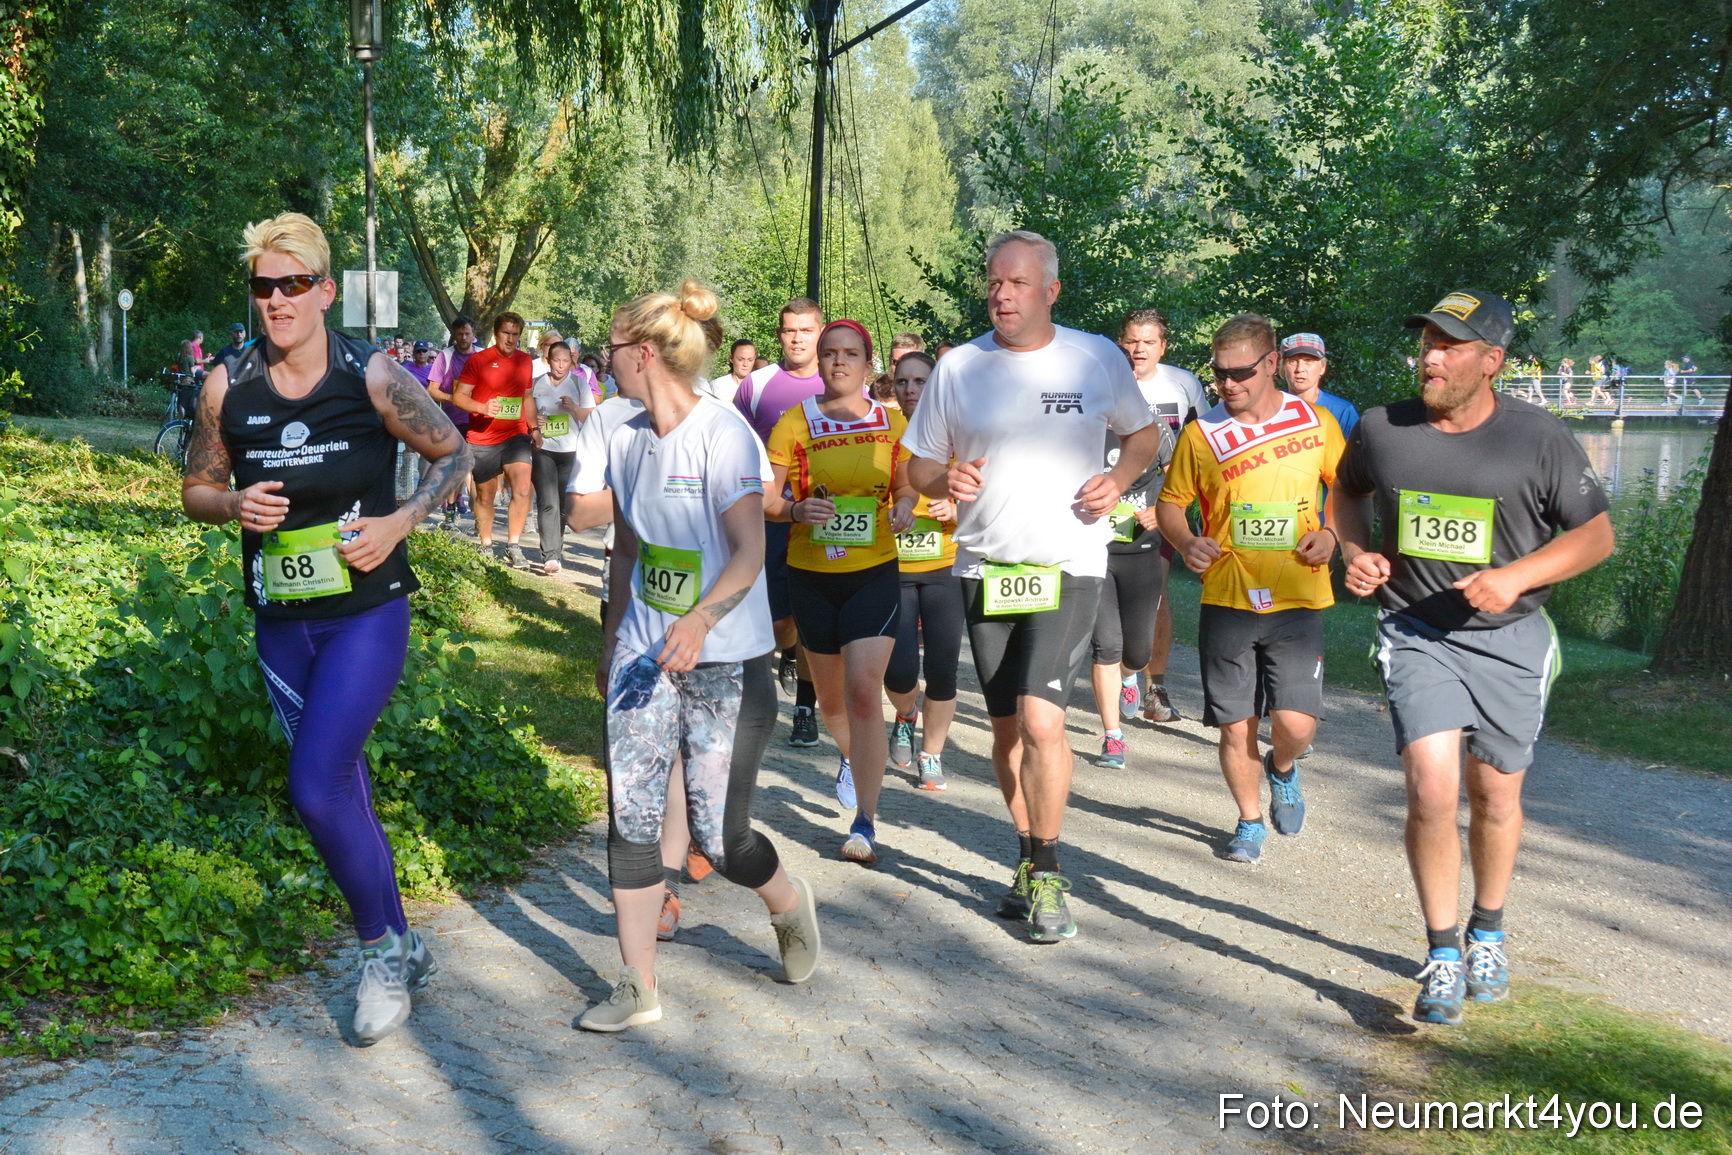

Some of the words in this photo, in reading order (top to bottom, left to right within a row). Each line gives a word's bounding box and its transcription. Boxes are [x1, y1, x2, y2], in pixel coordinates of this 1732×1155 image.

[1041, 399, 1084, 414] TGA
[246, 415, 271, 425] JAKO
[812, 437, 850, 452] MAX
[854, 432, 893, 444] BÖGL
[262, 454, 324, 468] SCHOTTERWERKE
[1221, 451, 1269, 483] MAX
[1272, 434, 1324, 460] BÖGL
[1238, 518, 1289, 536] 1327
[1410, 515, 1478, 544] 1368
[895, 532, 937, 549] 1324
[1419, 539, 1437, 547] Klein
[1438, 541, 1466, 550] Michael
[281, 554, 315, 580] 68
[302, 577, 335, 587] Christina
[1000, 576, 1042, 597] 806
